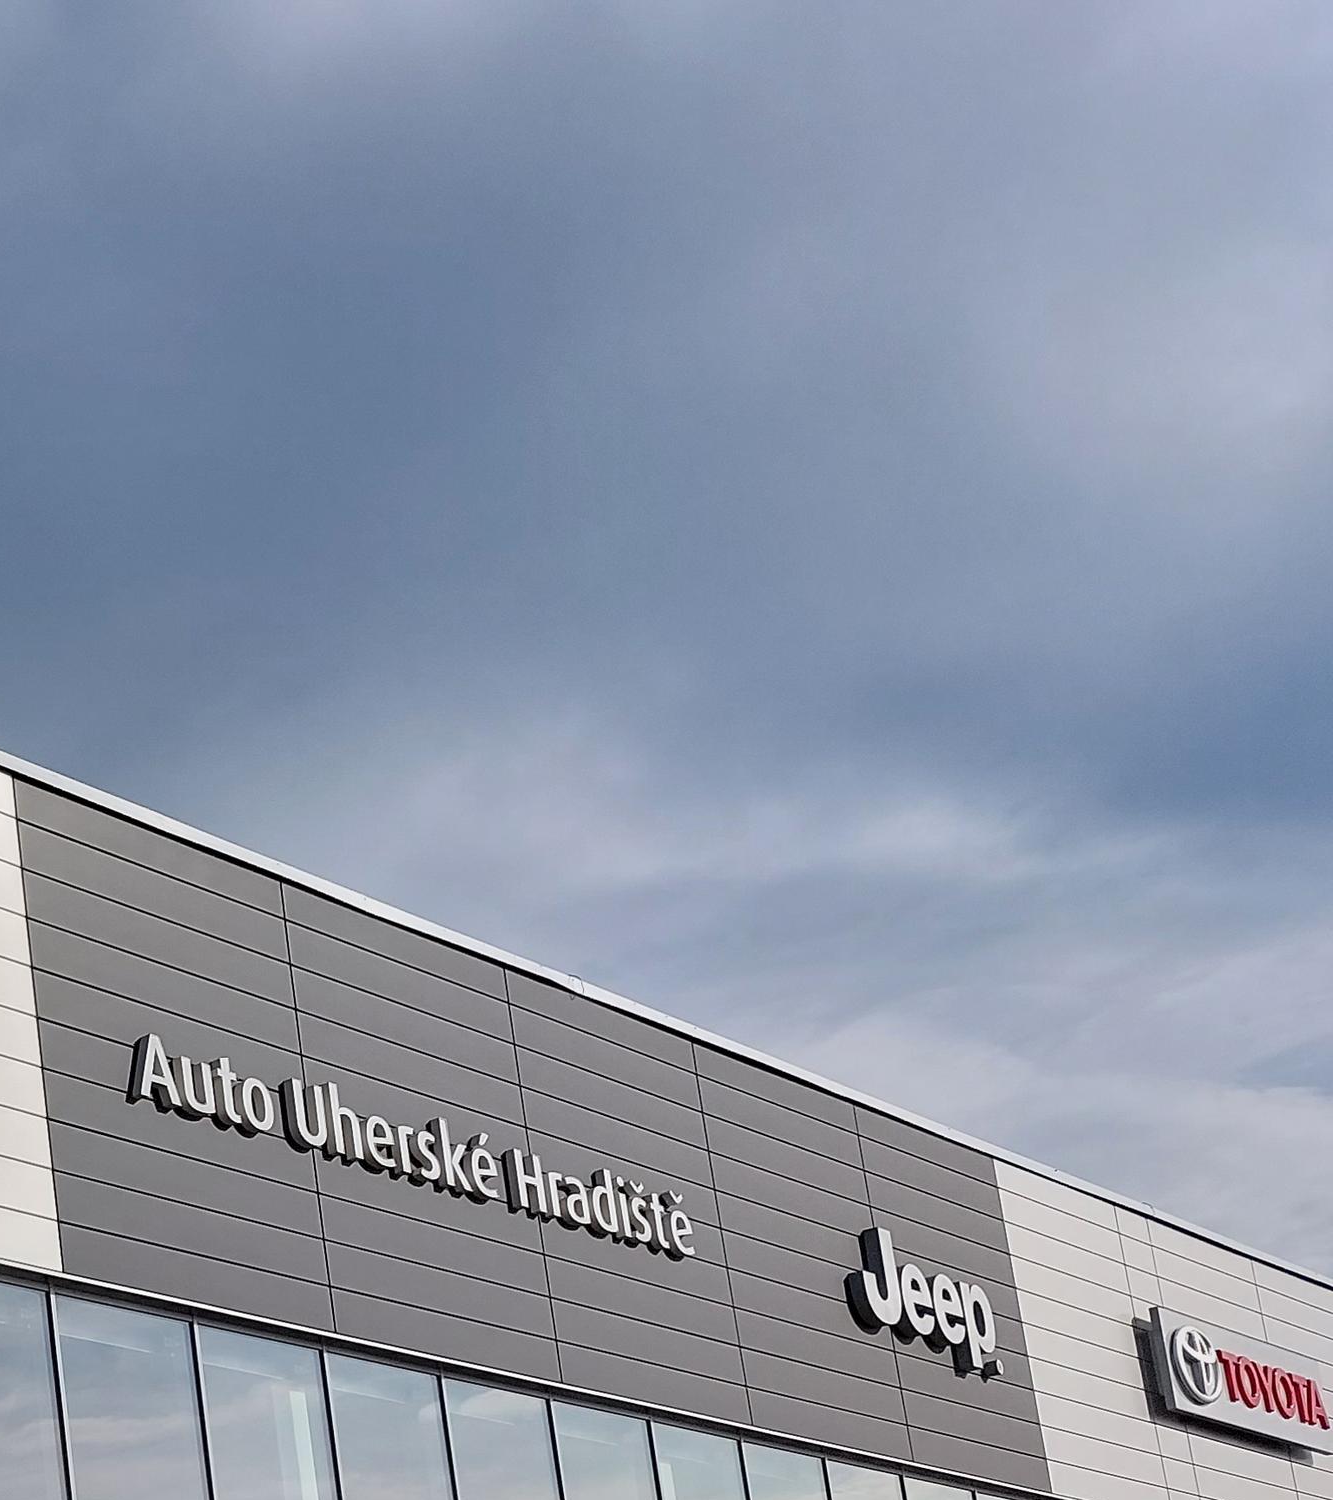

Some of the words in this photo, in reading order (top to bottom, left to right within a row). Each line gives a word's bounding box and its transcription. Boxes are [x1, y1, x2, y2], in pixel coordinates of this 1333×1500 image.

[135, 1033, 275, 1132] Auto
[288, 1077, 501, 1199] Uherské
[509, 1147, 695, 1256] Hradiště
[858, 1226, 998, 1371] Jeep
[1216, 1349, 1331, 1430] TOYOTA
